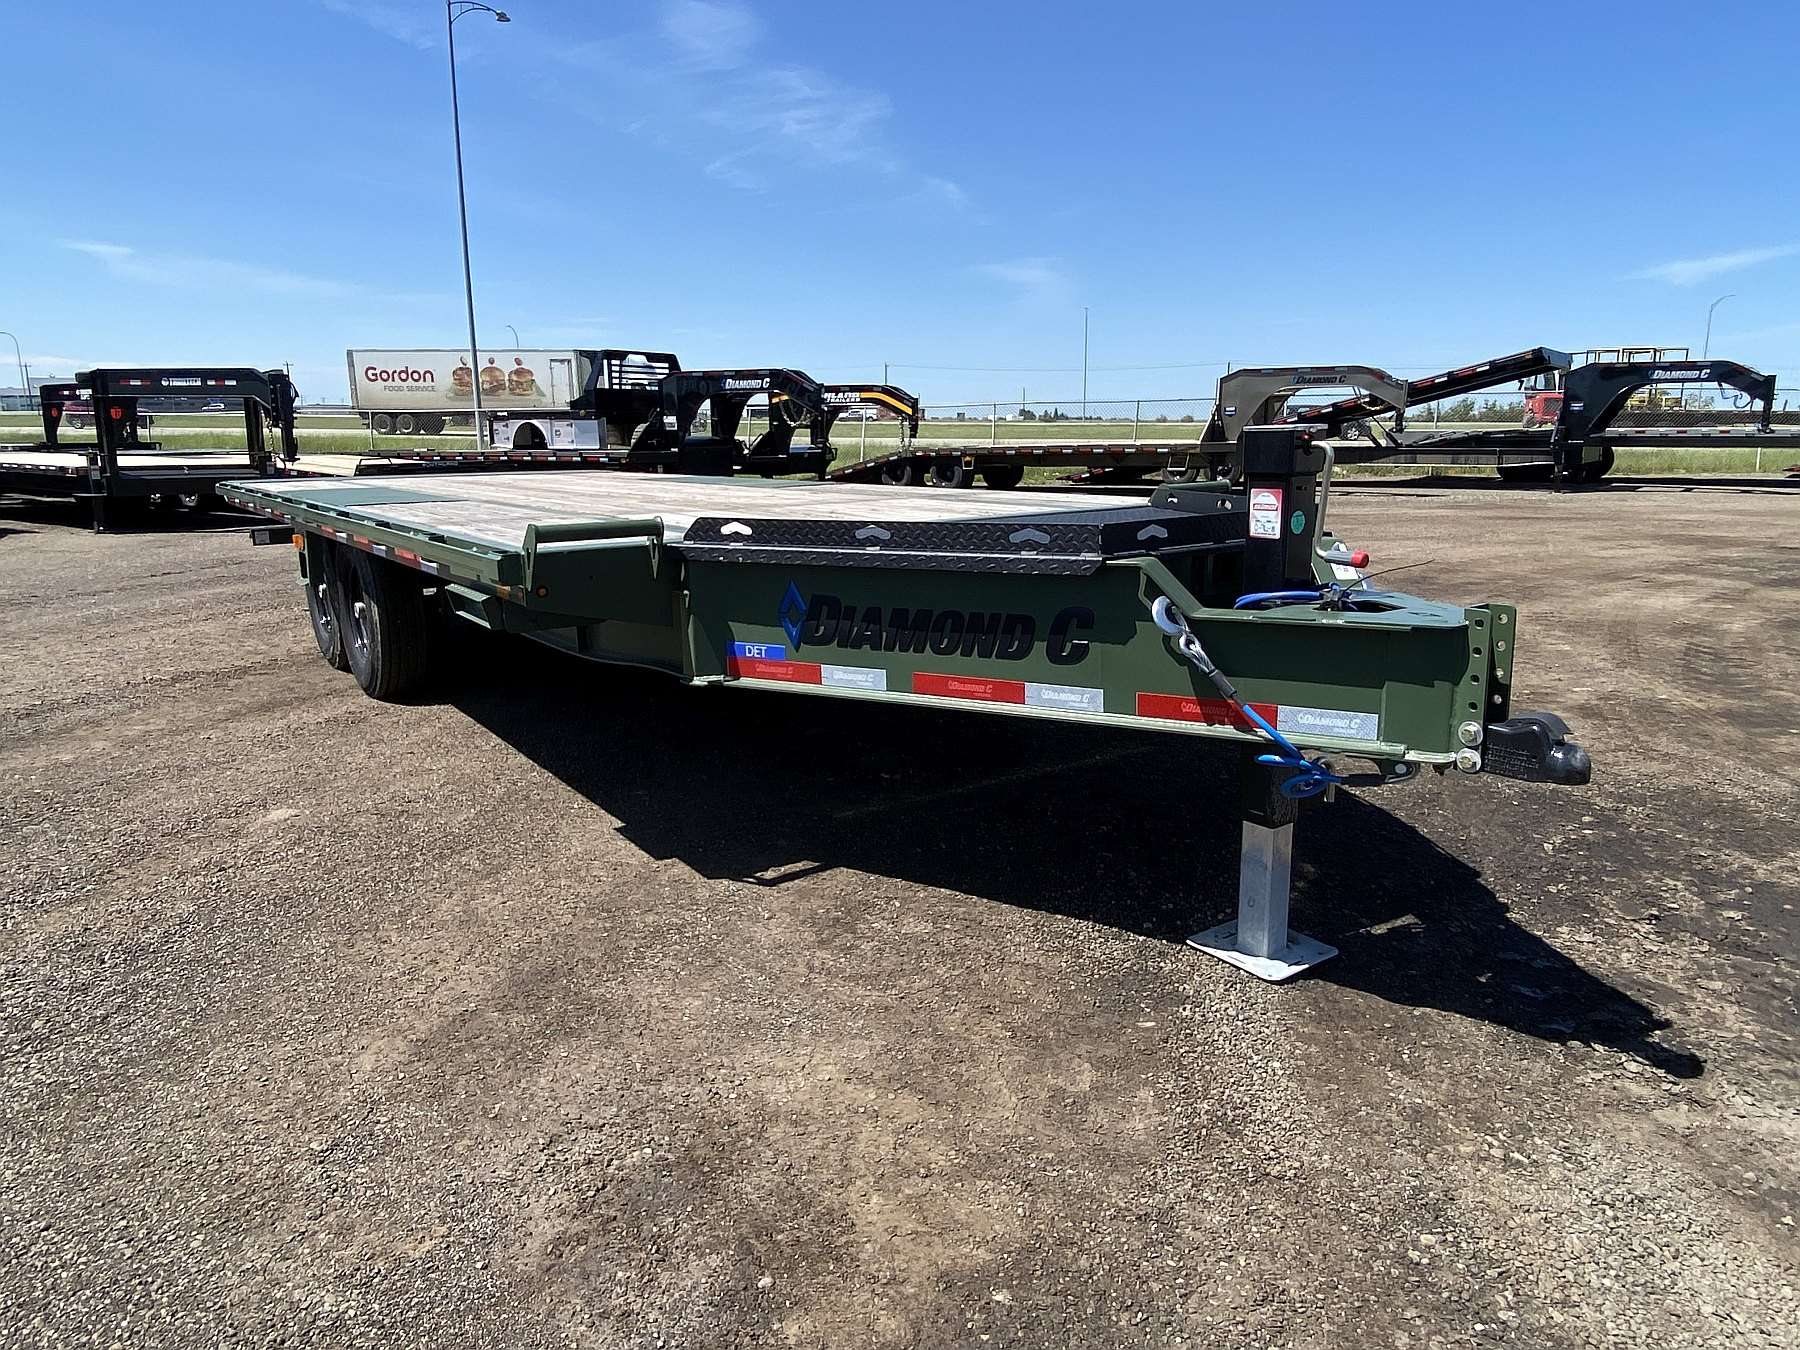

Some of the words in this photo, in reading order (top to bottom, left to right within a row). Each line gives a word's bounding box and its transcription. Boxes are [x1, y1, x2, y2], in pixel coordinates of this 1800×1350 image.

[364, 366, 434, 382] Gordon
[1296, 376, 1338, 384] DIAMOND
[1654, 370, 1700, 379] DIAMOND
[1700, 369, 1711, 379] C
[725, 378, 762, 389] DIAMOND
[762, 377, 771, 389] C
[801, 594, 1036, 662] DIAMOND
[1046, 607, 1095, 666] C
[745, 645, 767, 658] DET
